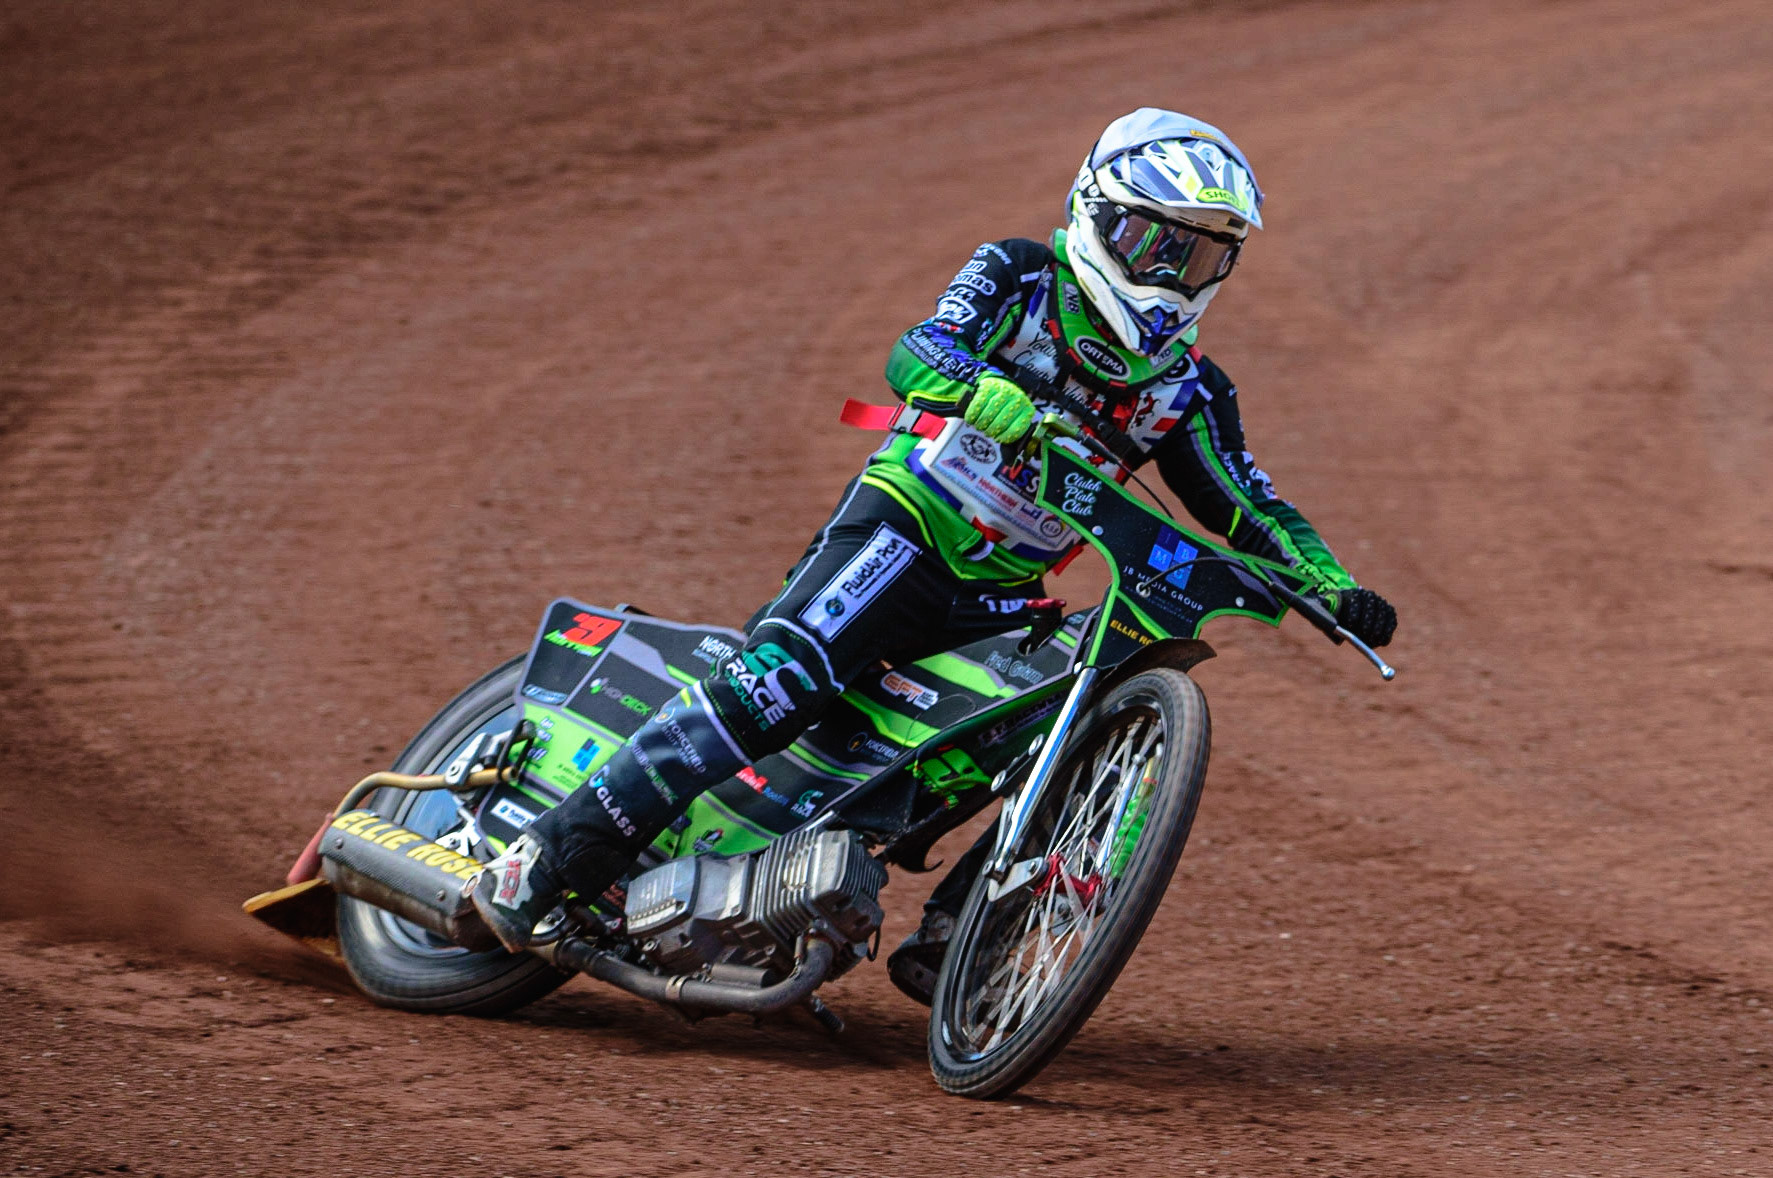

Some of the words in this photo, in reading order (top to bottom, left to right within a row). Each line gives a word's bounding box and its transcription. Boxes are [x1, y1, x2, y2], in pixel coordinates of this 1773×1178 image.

[1080, 342, 1124, 374] ORTEMA
[1064, 472, 1102, 492] Clutch
[1065, 485, 1096, 504] Plate
[1062, 499, 1094, 516] Club
[1123, 565, 1135, 576] JB
[1170, 589, 1204, 612] GROUP
[1110, 619, 1139, 640] ELLIE
[699, 635, 738, 659] NORTH
[726, 657, 786, 726] RACE
[332, 811, 423, 851] ELLIE
[406, 843, 484, 881] ROSE
